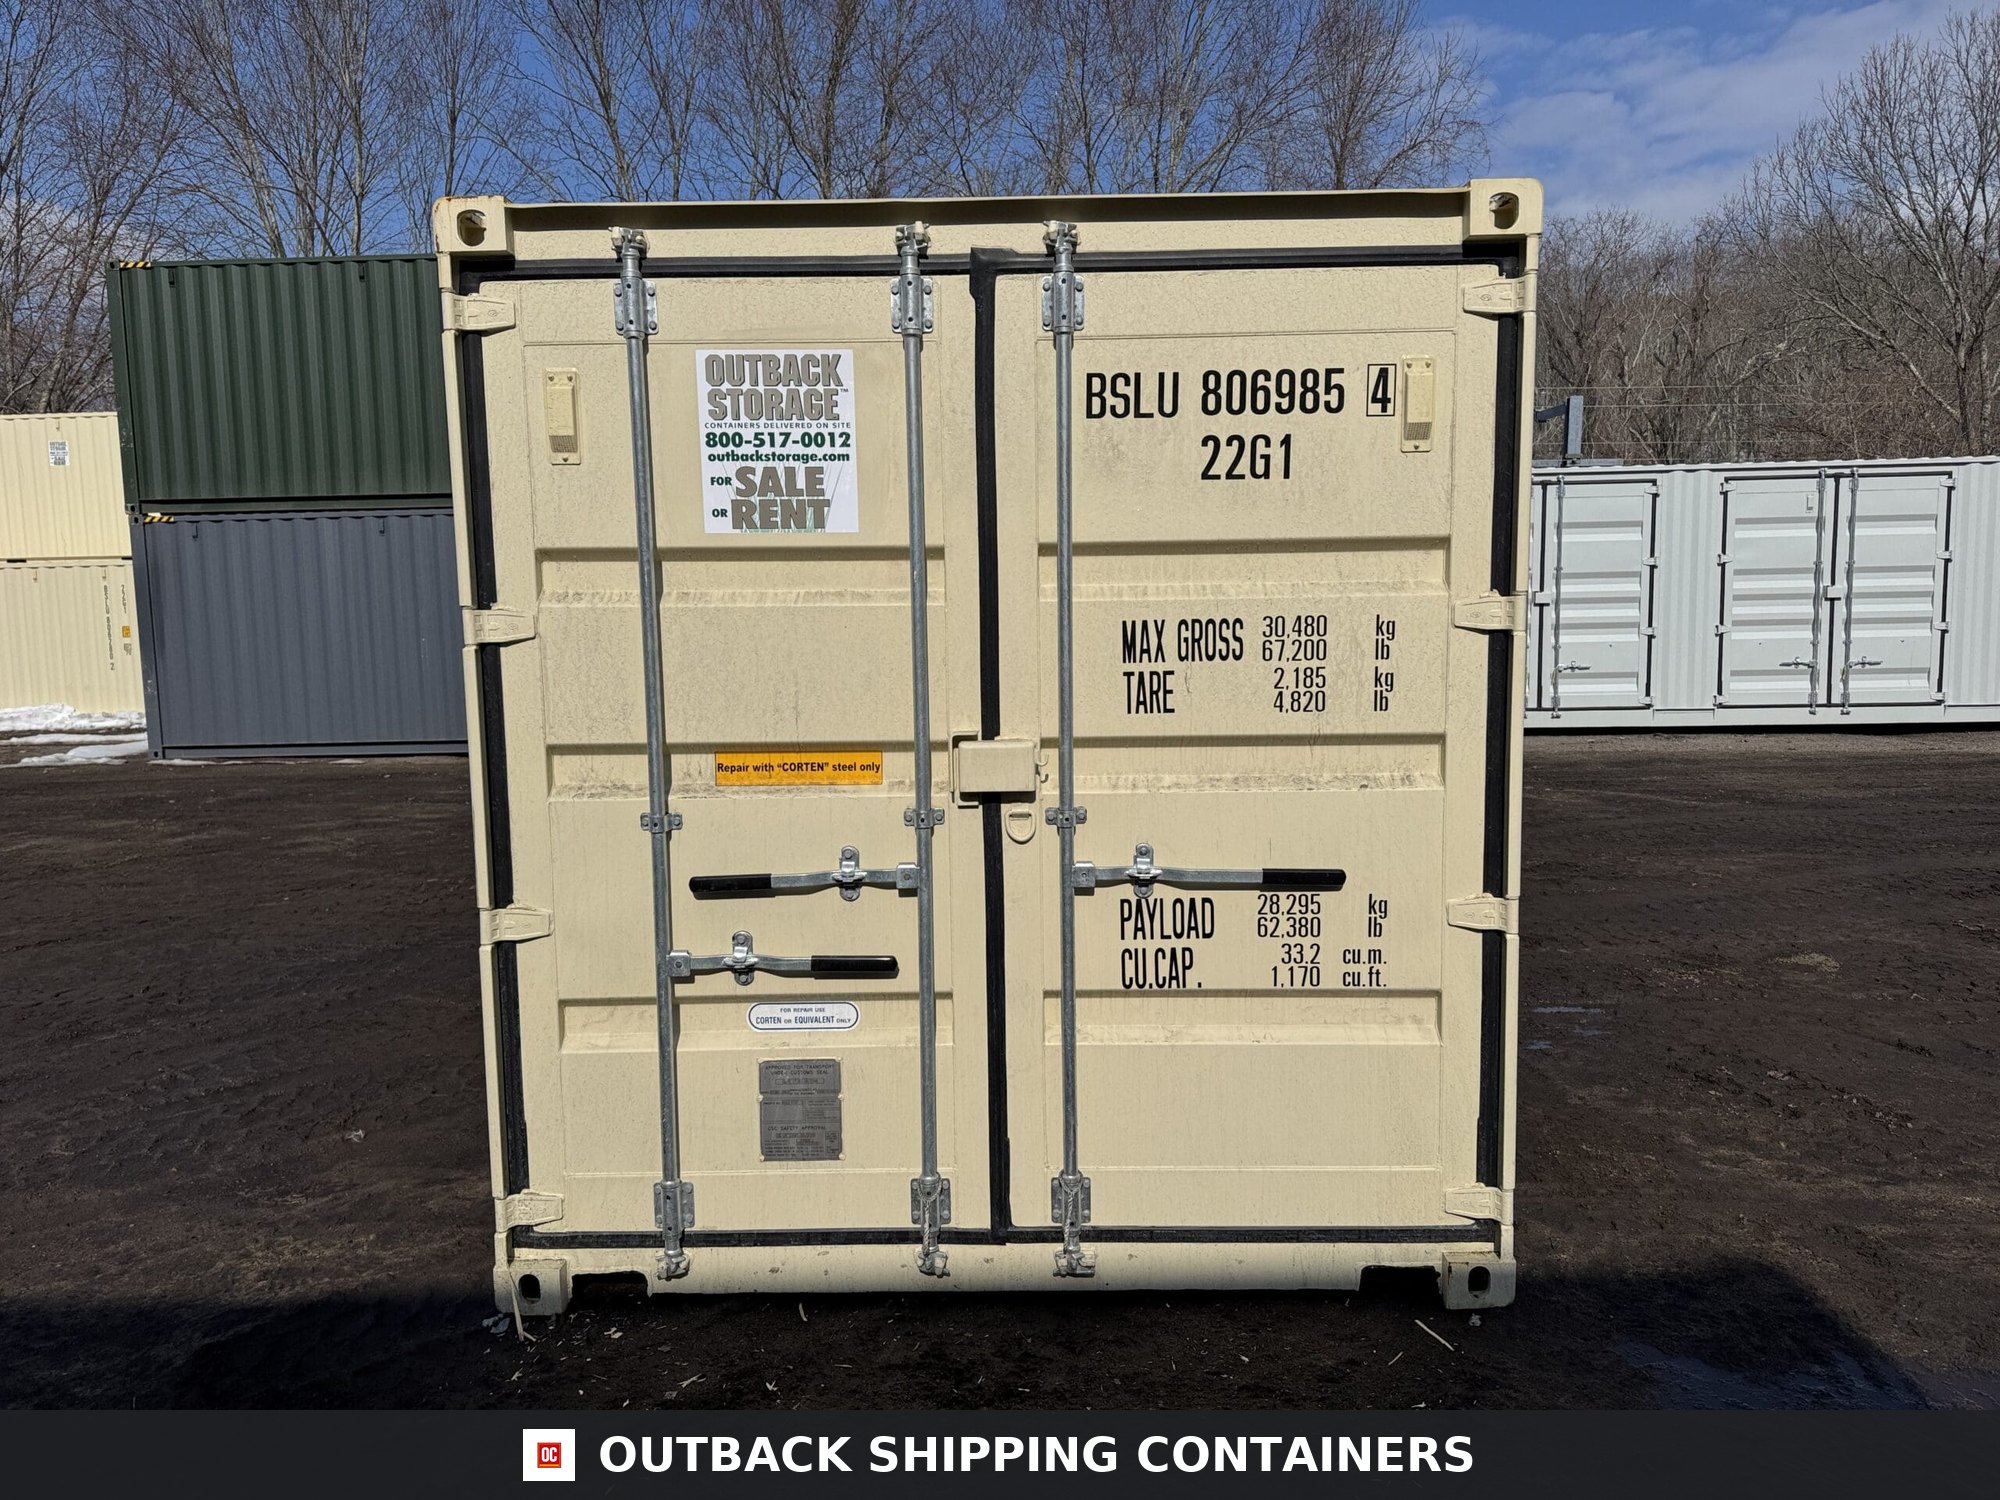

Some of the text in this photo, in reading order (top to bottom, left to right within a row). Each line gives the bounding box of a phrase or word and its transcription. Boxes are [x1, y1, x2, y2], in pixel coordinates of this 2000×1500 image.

[705, 354, 843, 387] OUTBACK
[707, 388, 840, 421] STORAGE
[1085, 366, 1392, 419] BSLU 806985 4
[705, 431, 851, 448] 800-517-0012
[708, 450, 850, 464] outbackstorage.com
[1200, 433, 1292, 480] 22G1
[710, 466, 825, 498] FOR SALE
[712, 499, 830, 530] OR RENT
[1121, 617, 1244, 663] MAX GROSS
[1262, 614, 1396, 641] 30,480 kg
[1262, 638, 1390, 663] 67,200 lb
[1123, 670, 1175, 714] TARE
[1273, 666, 1394, 693] 2,185 kg
[1273, 690, 1389, 714] 4,820 lb
[717, 763, 750, 774] Repair
[752, 762, 774, 772] with
[832, 762, 857, 772] steel
[859, 762, 881, 773] only
[1120, 898, 1215, 940] PAYLOAD
[1257, 893, 1388, 920] 28,295 kg
[1257, 916, 1383, 939] 62,380 lb
[1281, 943, 1387, 965] 33.2 cu.m.
[1271, 966, 1387, 988] 1,170 cu.ft.
[756, 1016, 782, 1024] CORTEN
[794, 1016, 834, 1024] EQUIVALENT
